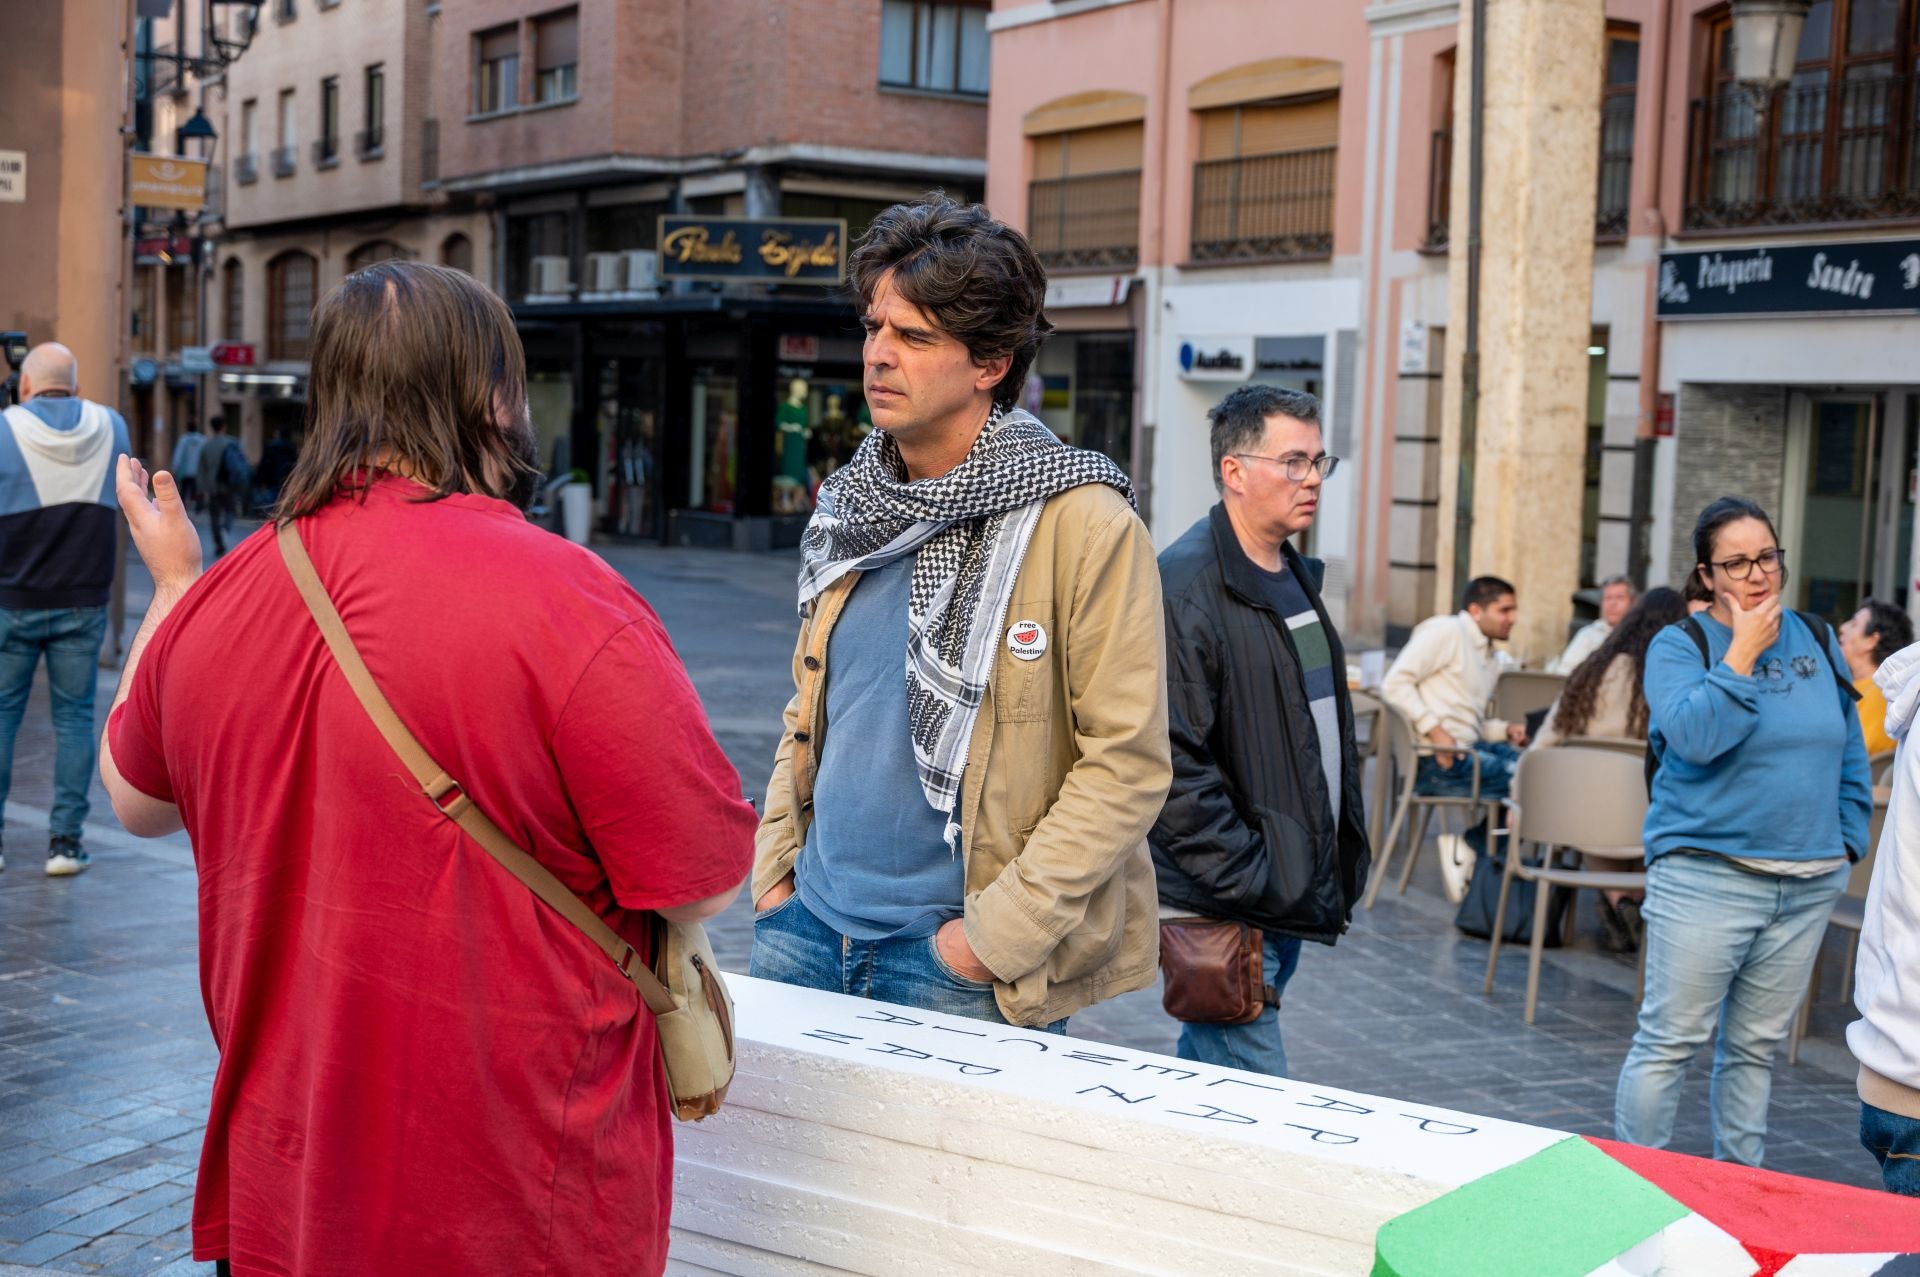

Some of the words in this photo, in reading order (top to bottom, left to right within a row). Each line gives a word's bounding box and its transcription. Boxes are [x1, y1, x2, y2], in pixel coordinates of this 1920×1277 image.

[1807, 252, 1875, 299] Sandra
[1010, 646, 1043, 654] Palestine
[856, 1010, 1479, 1135] PALENCIA
